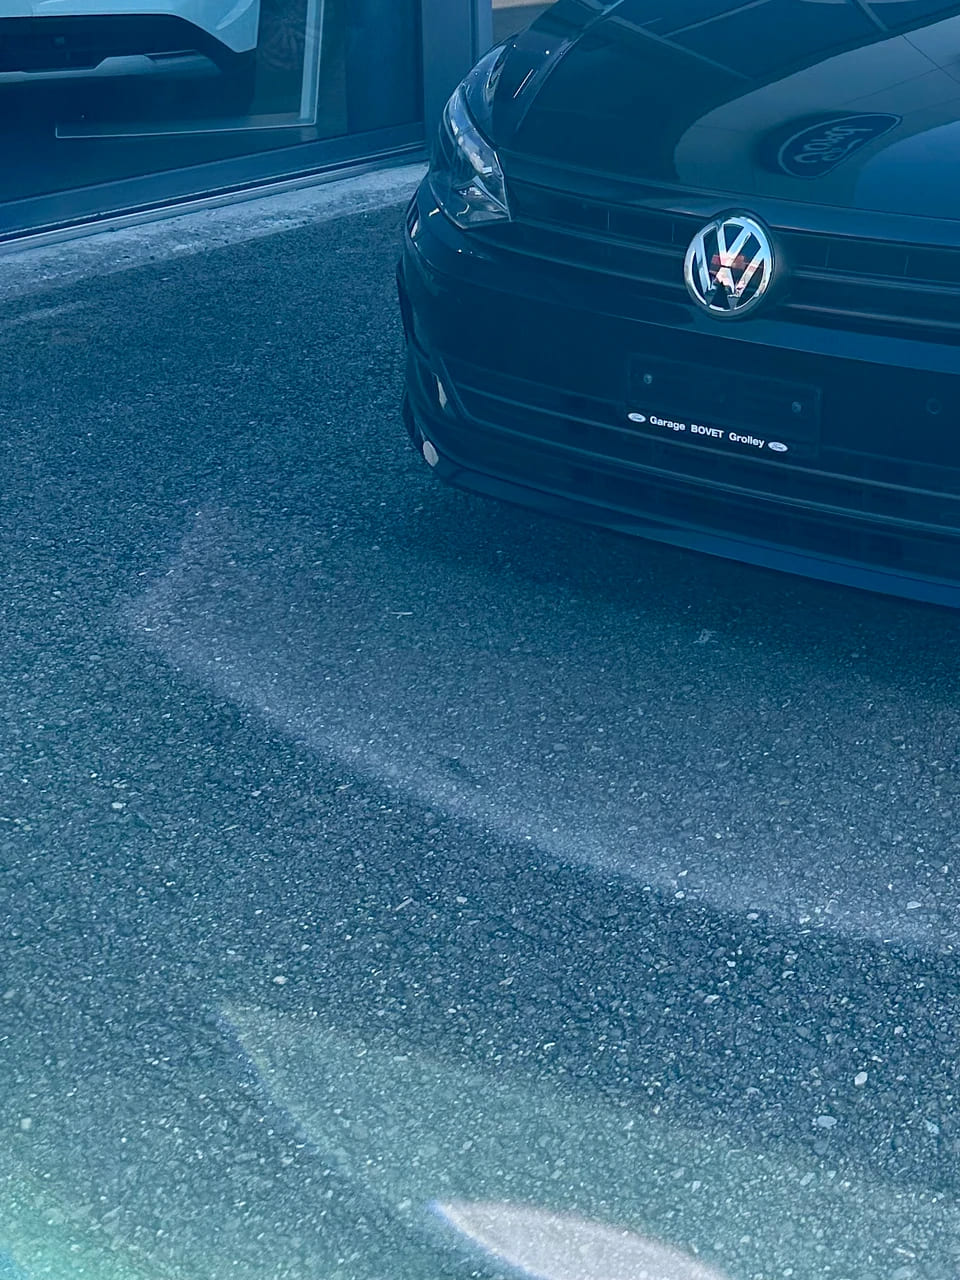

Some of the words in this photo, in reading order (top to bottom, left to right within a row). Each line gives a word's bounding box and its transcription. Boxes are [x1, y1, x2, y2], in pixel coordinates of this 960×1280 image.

[650, 415, 686, 431] Garage
[690, 424, 725, 439] BOVET
[728, 432, 765, 449] Grolley
